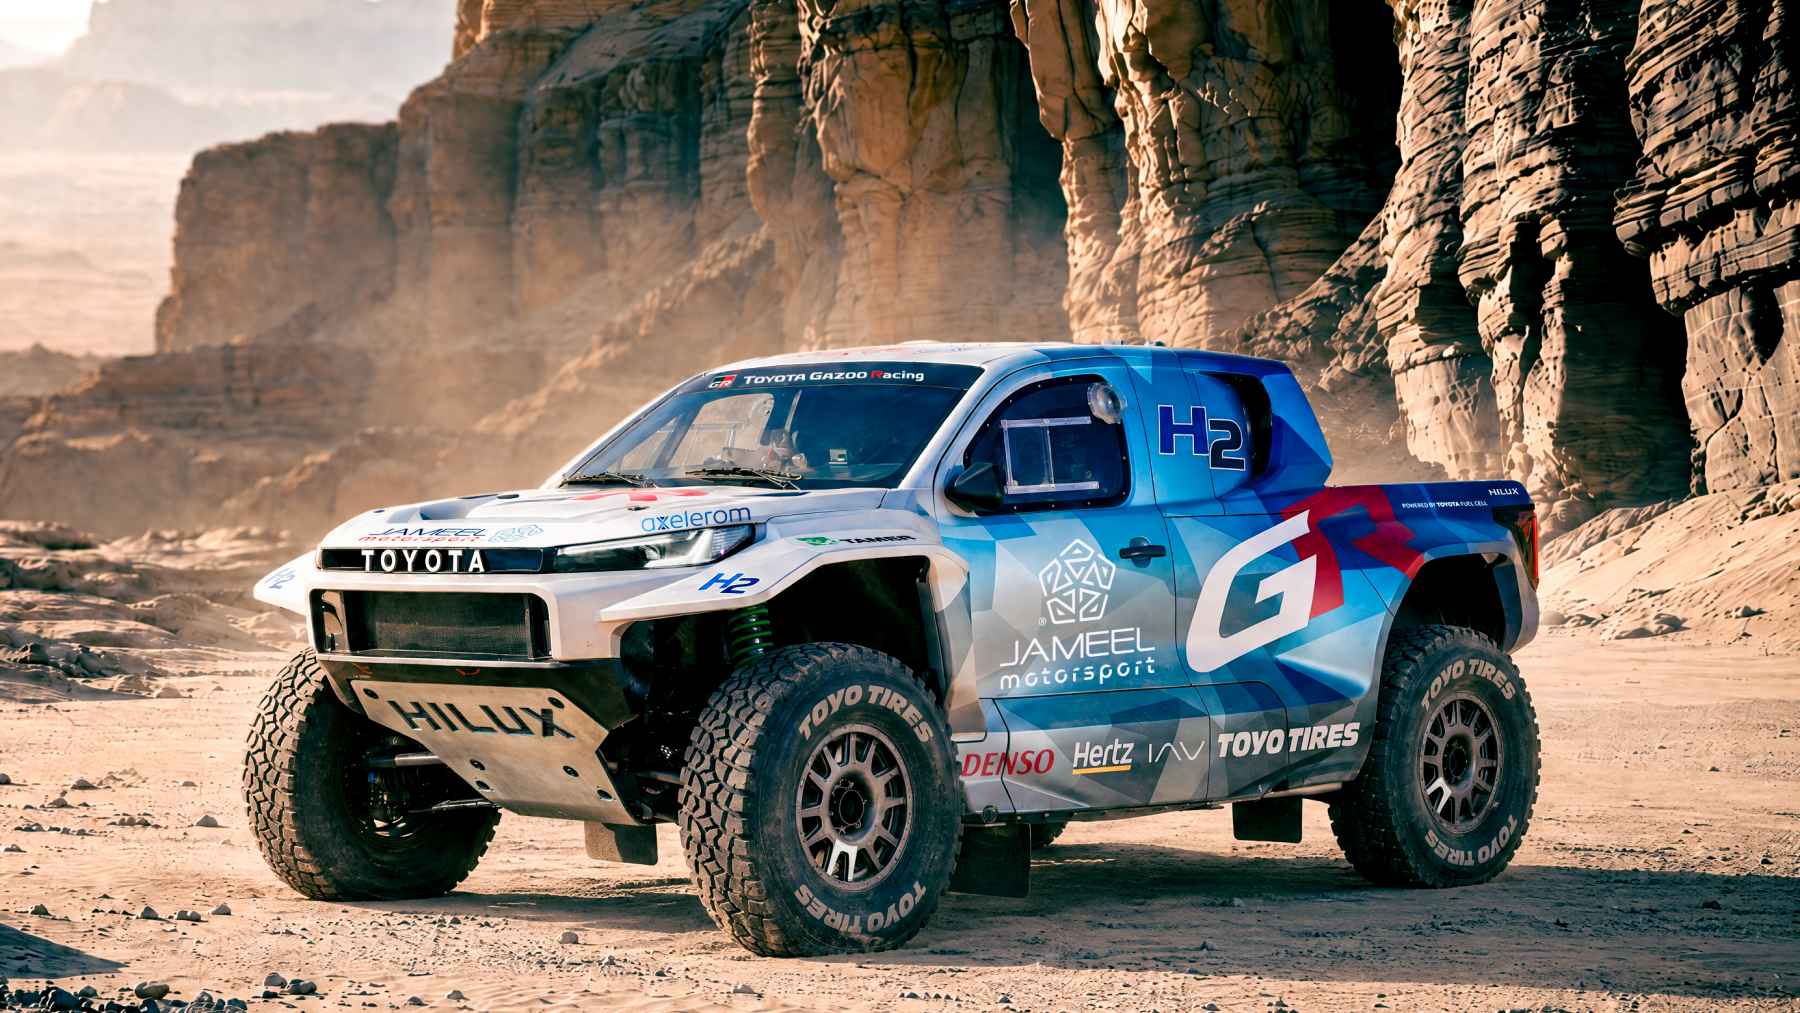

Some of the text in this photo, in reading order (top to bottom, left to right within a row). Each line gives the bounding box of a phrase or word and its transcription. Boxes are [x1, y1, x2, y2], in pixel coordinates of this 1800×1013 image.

[809, 371, 867, 381] GAZOO
[870, 370, 924, 382] Racing
[1157, 404, 1246, 471] H2
[1487, 487, 1519, 496] HILUX
[368, 528, 487, 536] JAMEEL
[641, 507, 751, 532] axelerom
[839, 535, 916, 544] TAMER
[361, 549, 486, 573] TOYOTA
[698, 573, 760, 593] H2
[1000, 627, 1155, 667] JAMEEL
[1000, 656, 1155, 690] motorsport
[1421, 658, 1516, 712] TOYO TIRES
[387, 699, 577, 740] HILUX
[798, 685, 934, 743] TOYO TIRES
[1072, 738, 1135, 768] Hertz
[1218, 722, 1360, 758] TOYO TIRES
[960, 748, 1055, 777] DENSO
[1424, 815, 1518, 867] TOYO TIRES
[794, 880, 927, 934] TOYO TIRES
